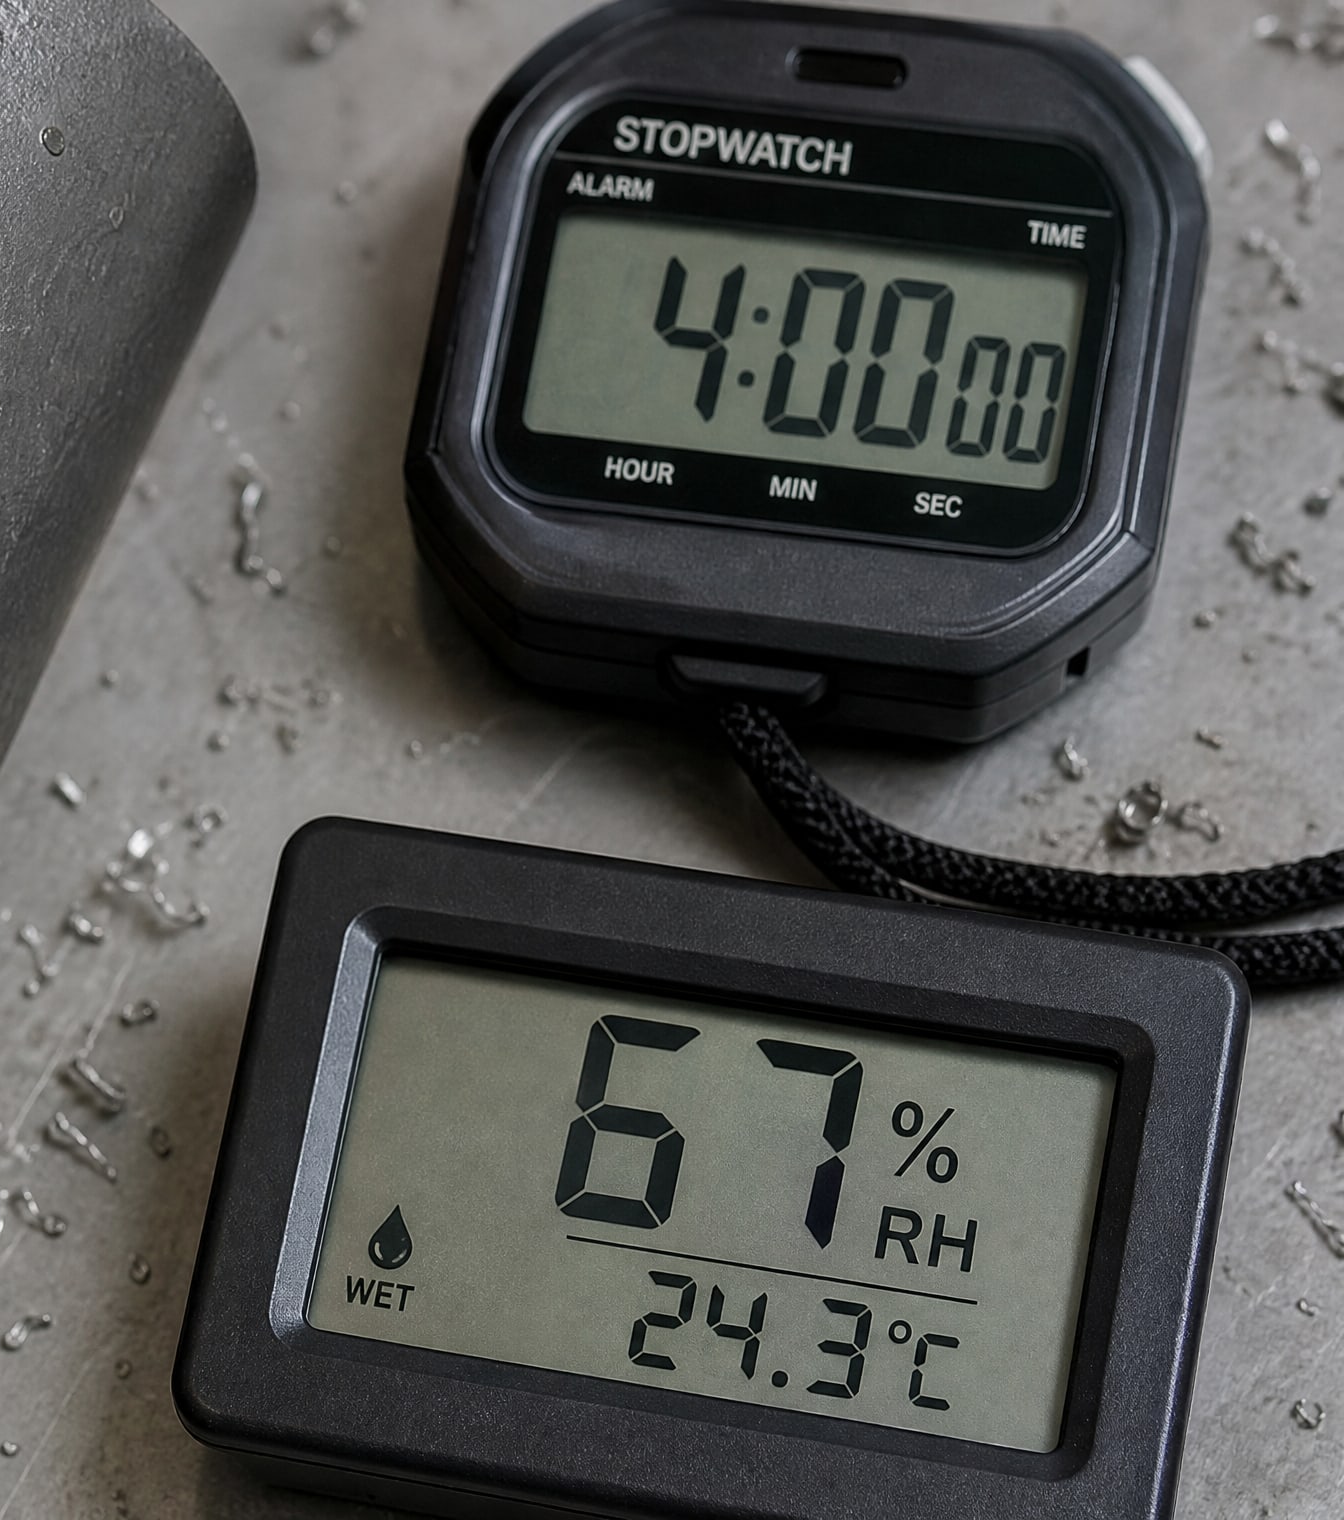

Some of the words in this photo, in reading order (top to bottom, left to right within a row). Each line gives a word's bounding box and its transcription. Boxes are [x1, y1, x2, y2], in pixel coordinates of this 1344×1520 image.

[613, 116, 853, 176] STOPWATCH
[567, 171, 655, 202] ALARM
[1027, 219, 1087, 250] TIME
[604, 456, 675, 486] HOUR
[769, 475, 818, 502] MIN
[913, 491, 963, 518] SEC
[554, 1014, 864, 1250] 67
[891, 1100, 959, 1184] %
[874, 1205, 978, 1273] RH
[346, 1275, 416, 1312] WET
